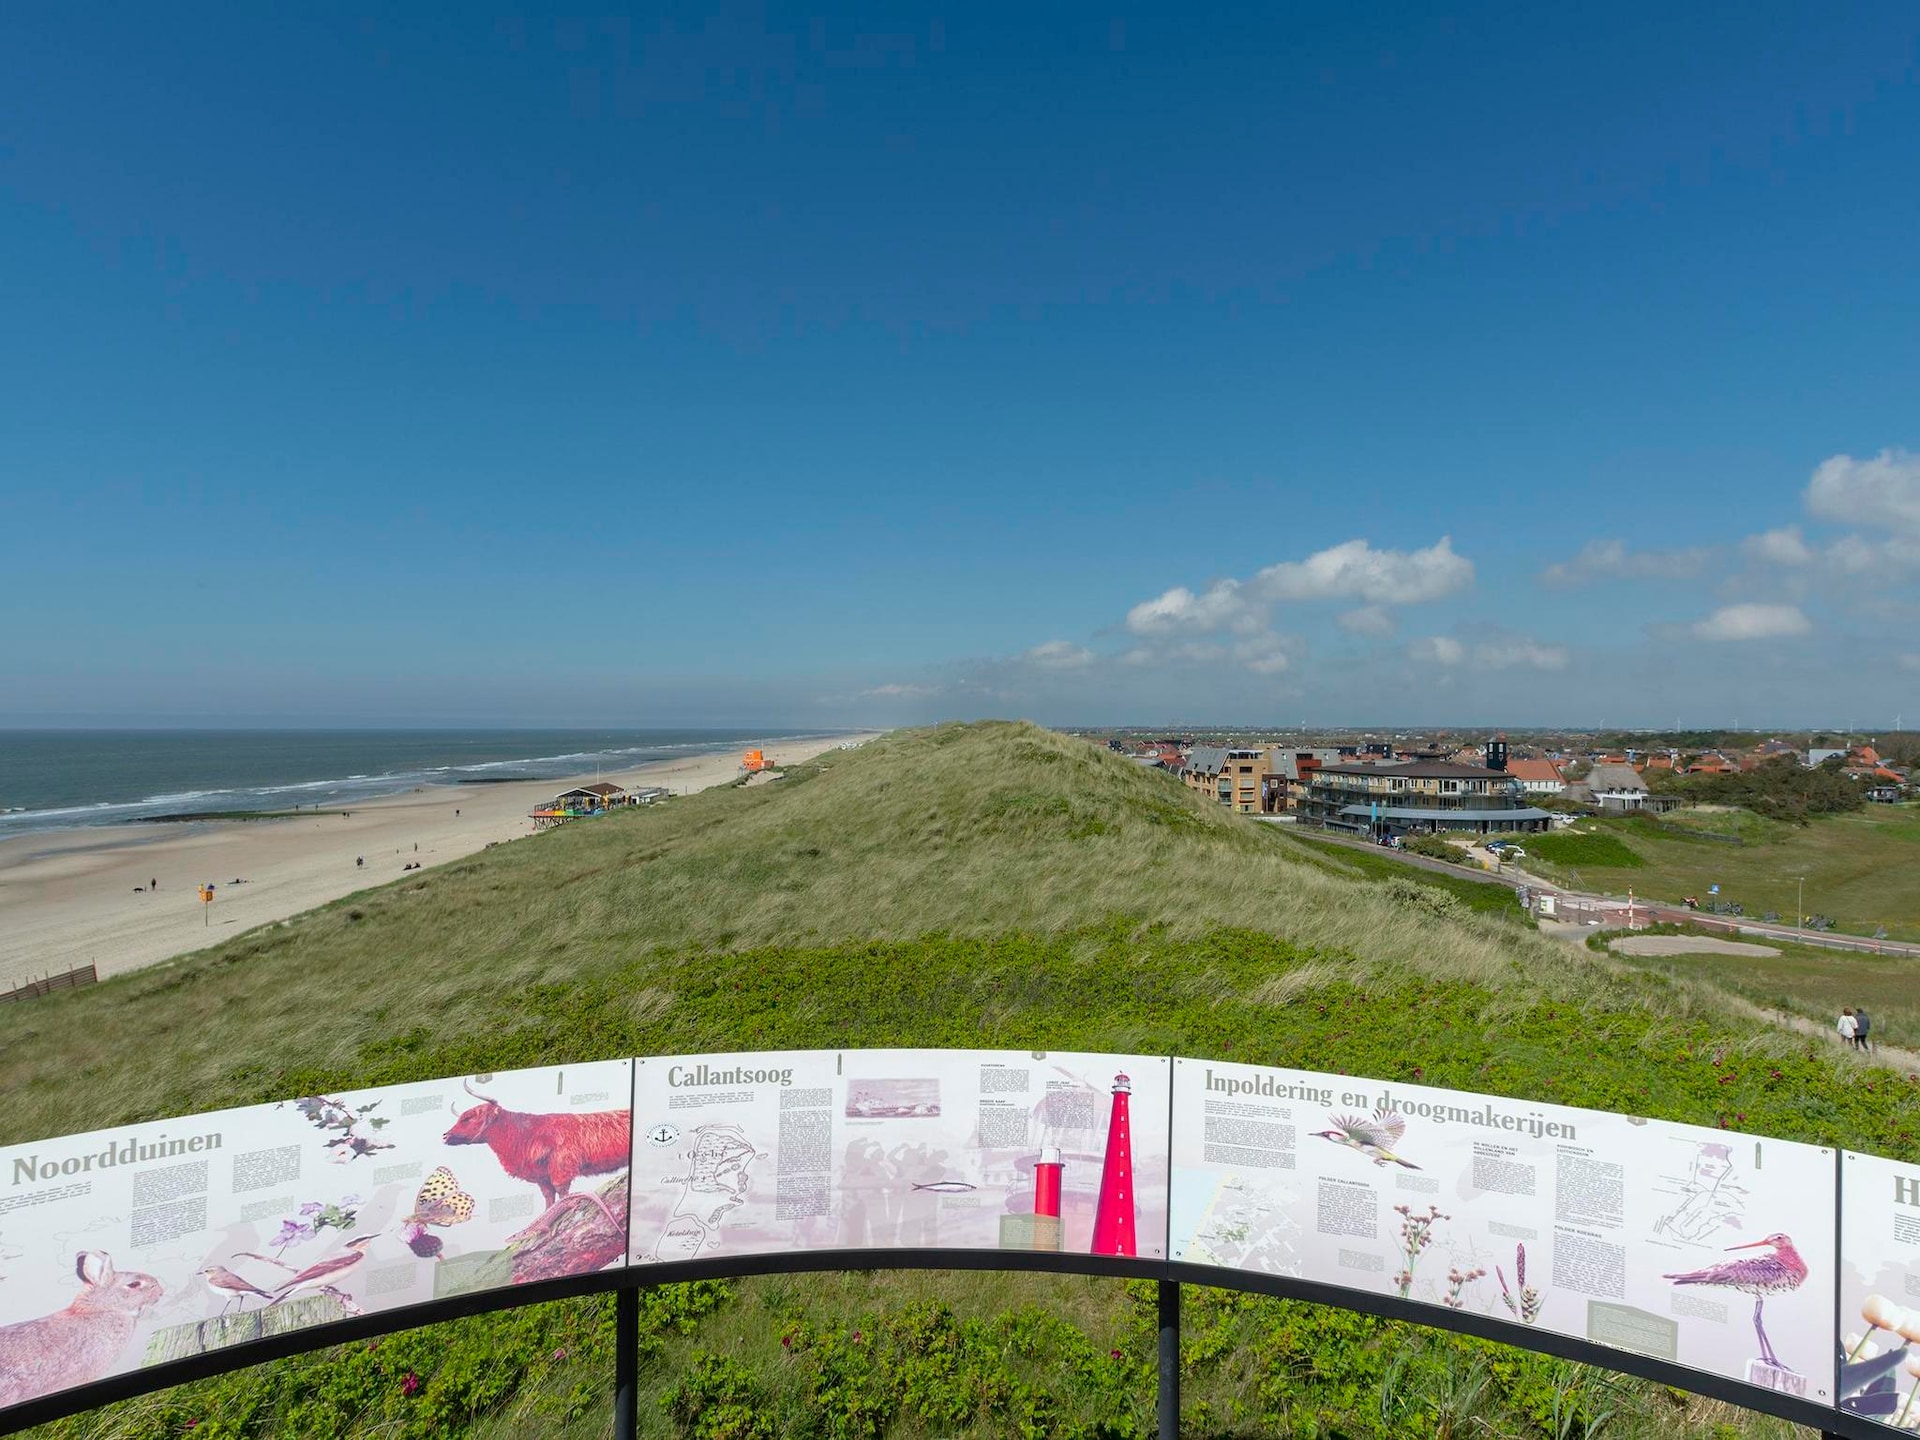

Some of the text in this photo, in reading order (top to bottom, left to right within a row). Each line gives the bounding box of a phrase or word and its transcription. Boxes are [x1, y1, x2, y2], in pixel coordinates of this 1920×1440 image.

[668, 1064, 794, 1088] Callantsoog
[1205, 1069, 1576, 1140] Inpoldering en droogmakerijen
[12, 1132, 222, 1186] Noordduinen
